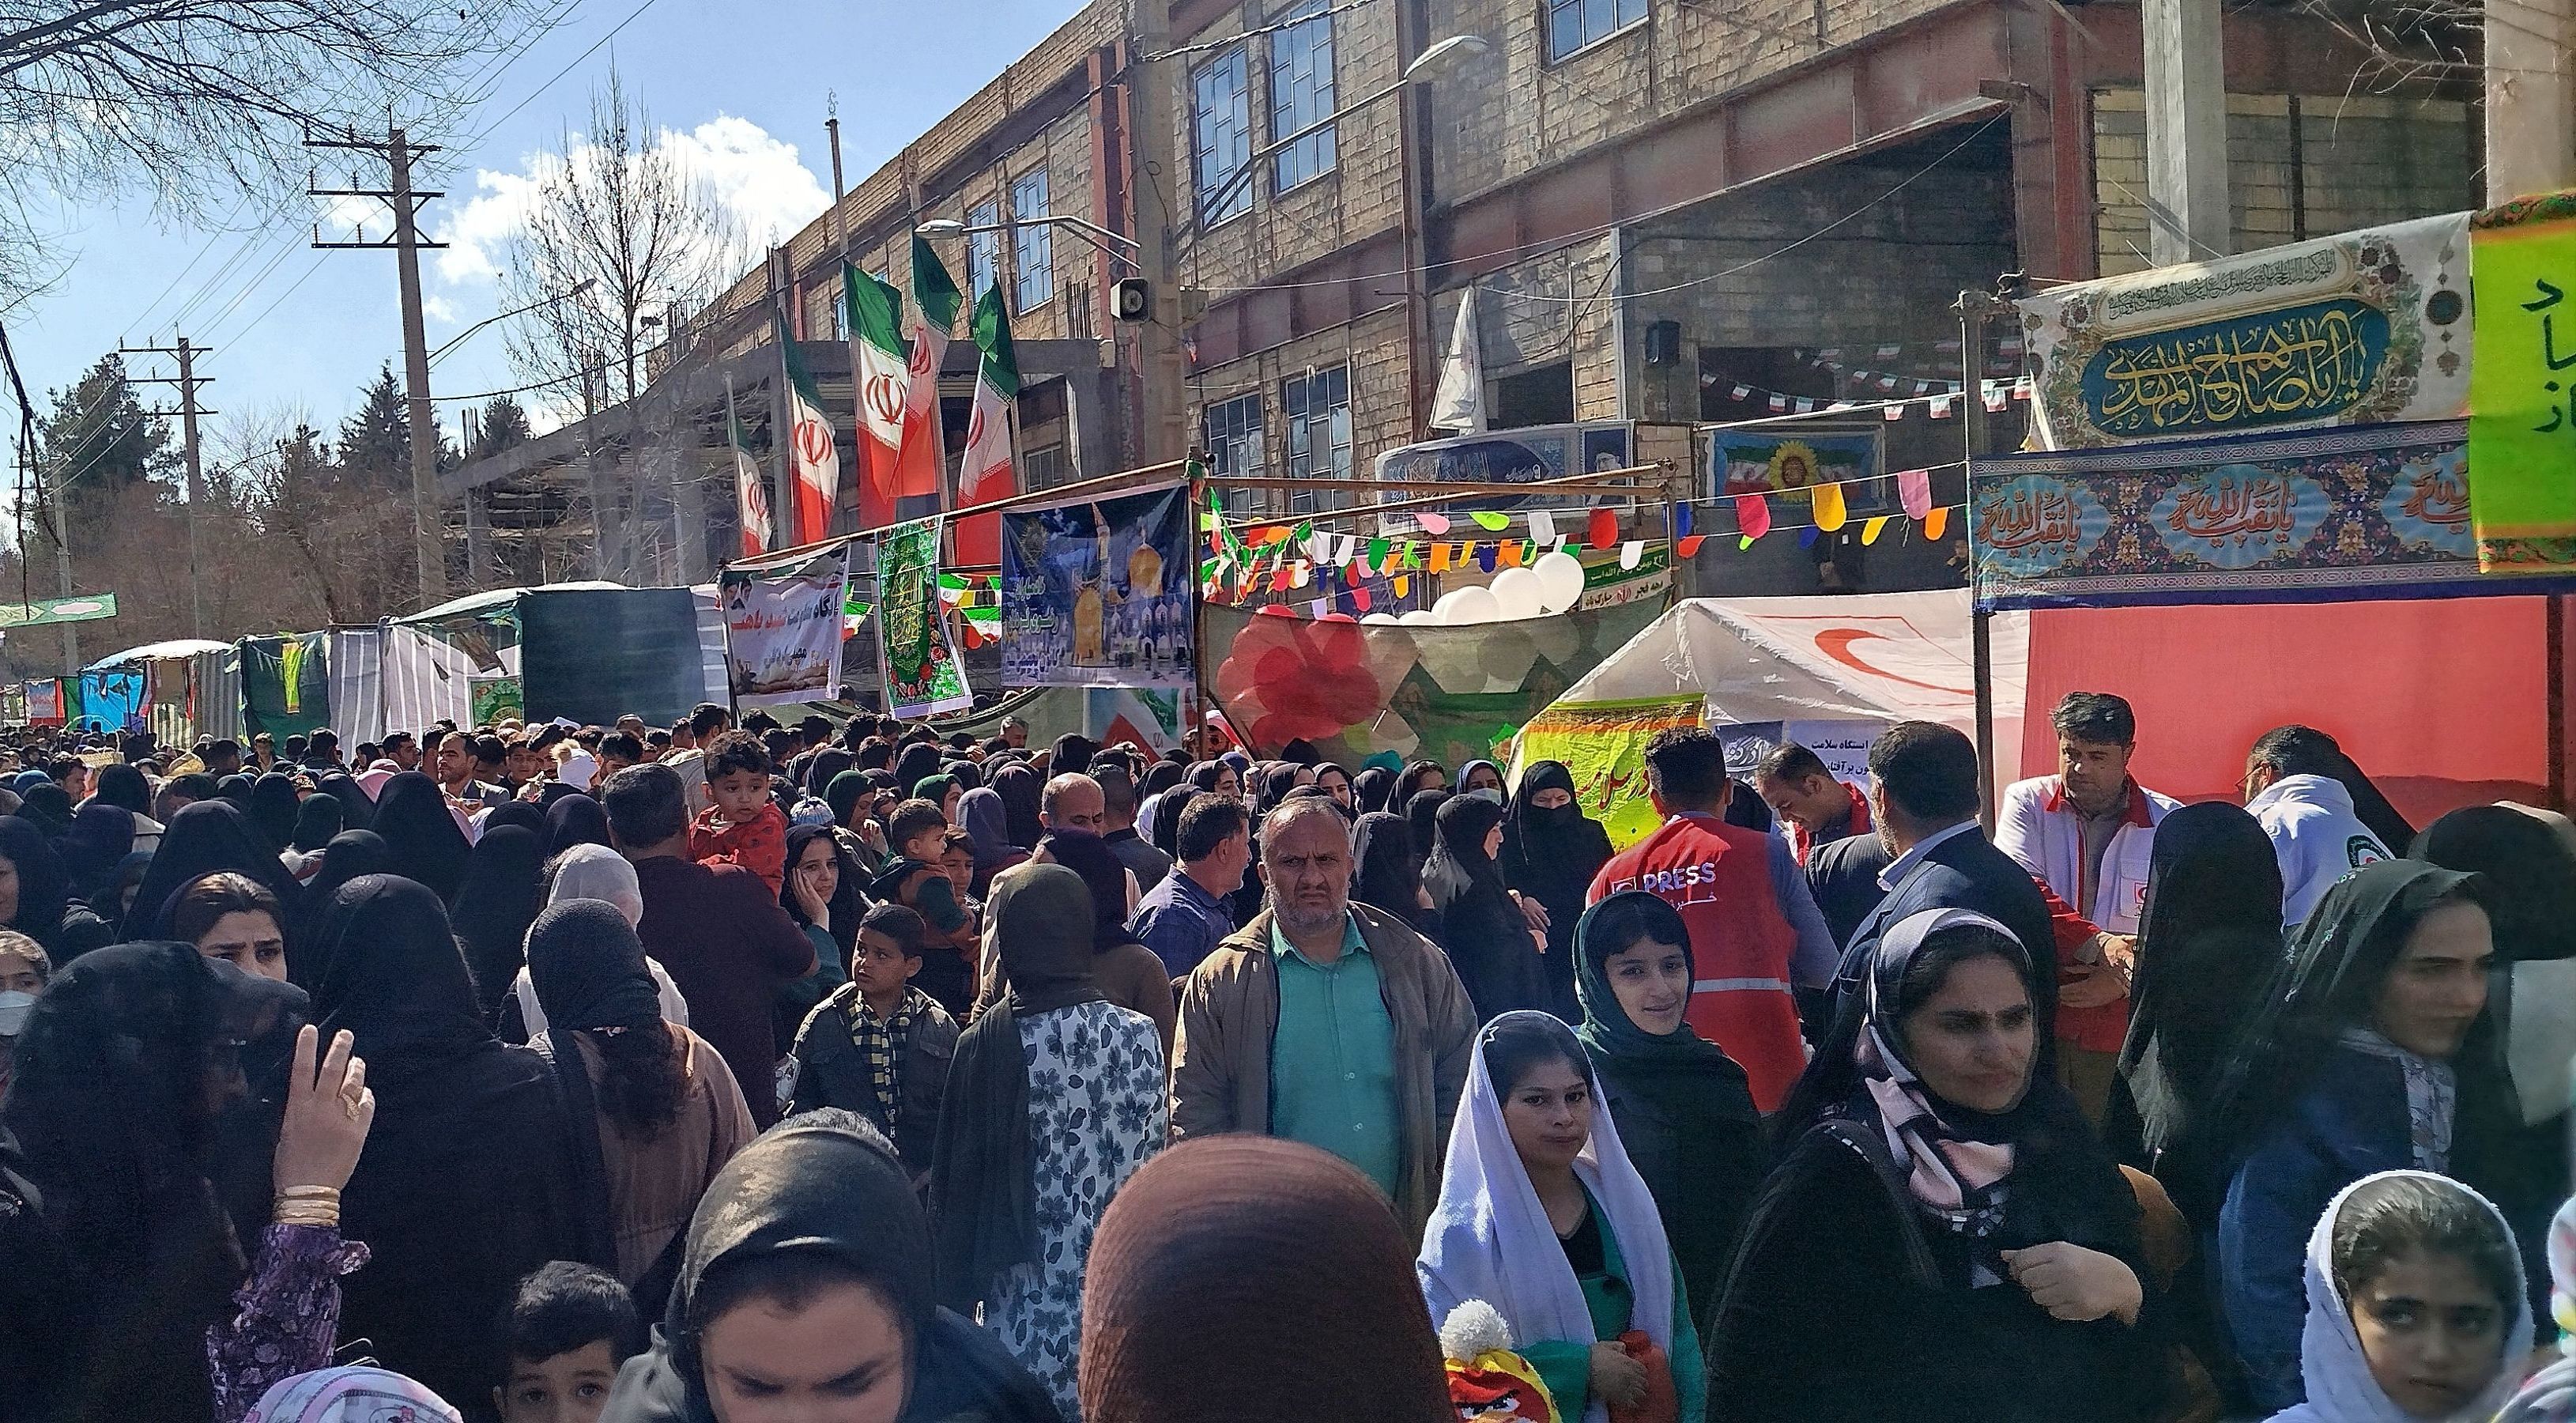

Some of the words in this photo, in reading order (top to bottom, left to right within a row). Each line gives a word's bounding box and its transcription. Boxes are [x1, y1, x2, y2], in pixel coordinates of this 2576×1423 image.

[1997, 490, 2042, 532] الله
[2195, 478, 2254, 519] الله
[1812, 738, 1838, 749] سلامت
[1839, 739, 1869, 752] ایستگاه
[1643, 862, 1717, 893] PRESS
